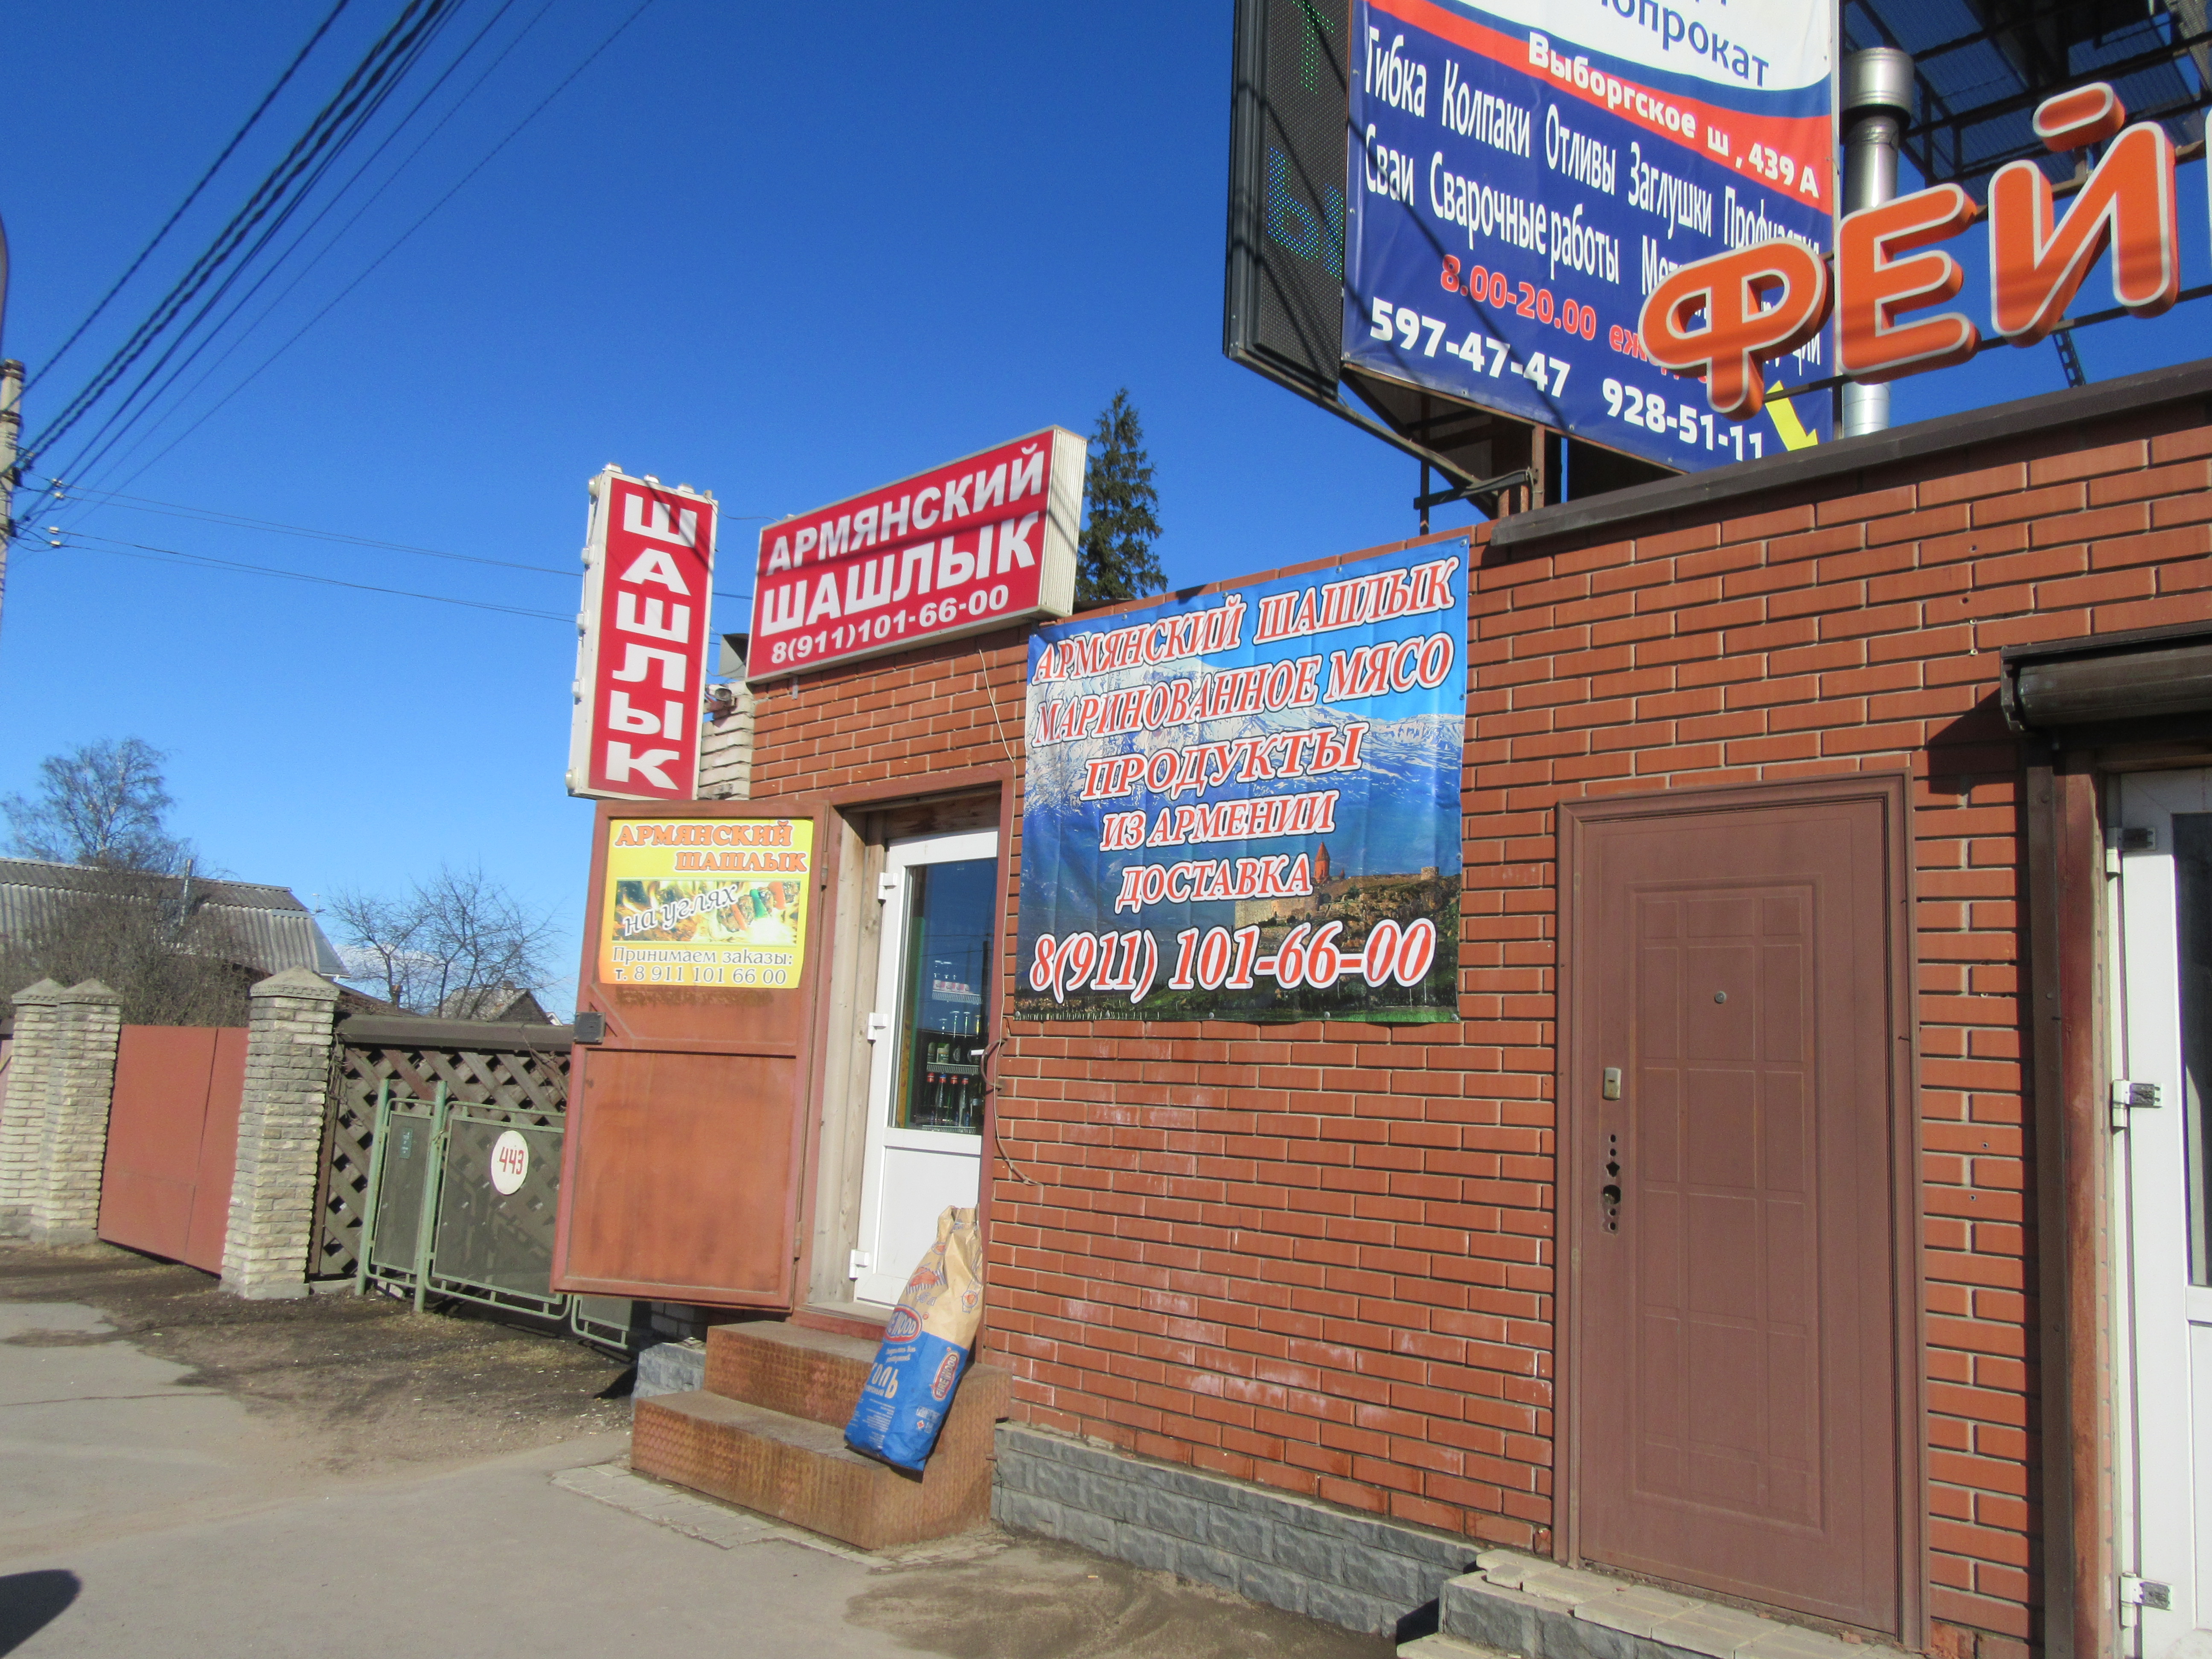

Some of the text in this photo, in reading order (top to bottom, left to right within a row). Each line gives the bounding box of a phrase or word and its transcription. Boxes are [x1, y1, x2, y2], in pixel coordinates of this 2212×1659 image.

[1601, 0, 1769, 88] опрокат
[1365, 26, 1428, 118] Гибка
[1442, 59, 1530, 159] Колпаки
[1545, 103, 1616, 195] Отливы
[1628, 143, 1712, 240] Заглушки
[1528, 31, 1697, 138] Выборгское
[1749, 143, 1795, 186] 439
[1365, 123, 1415, 206] Сваи
[1429, 151, 1547, 254] Сварочные
[1549, 204, 1619, 285] работы
[1638, 82, 2212, 420] ФЕЙ
[1440, 254, 1597, 341] 8.00-20.00
[1370, 297, 1571, 398] 597-47-47
[1603, 378, 1763, 462] 928-51-11
[767, 442, 1045, 575] АРМЯНСКИЙ
[760, 513, 1039, 636] ШАШЛЫК
[604, 493, 698, 790] ШАШЛЫК
[771, 584, 1009, 664] 8(911)101-66-00
[1033, 556, 1458, 684] АРМЯНСКИЙ ШАШЛЫК
[1032, 632, 1453, 747] МАРИНОВАННОЕ МЯСО
[1080, 722, 1369, 800] ПРОДУКТЫ
[615, 820, 793, 846] АРМЯНСКИЙ
[675, 852, 807, 872] ШАШЛЫК
[1100, 791, 1339, 852] ИЗ АРМЕНИИ
[624, 885, 739, 936] на углях
[1115, 853, 1313, 913] ДОСТАВКА
[613, 947, 793, 965] Принимаем заказы:
[634, 966, 645, 981] 8
[652, 966, 683, 981] 911
[693, 967, 724, 983] 101
[732, 968, 756, 984] 66
[763, 969, 786, 984] 00
[1029, 917, 1437, 1004] 8(911) 101-66-00
[498, 1146, 524, 1175] 443
